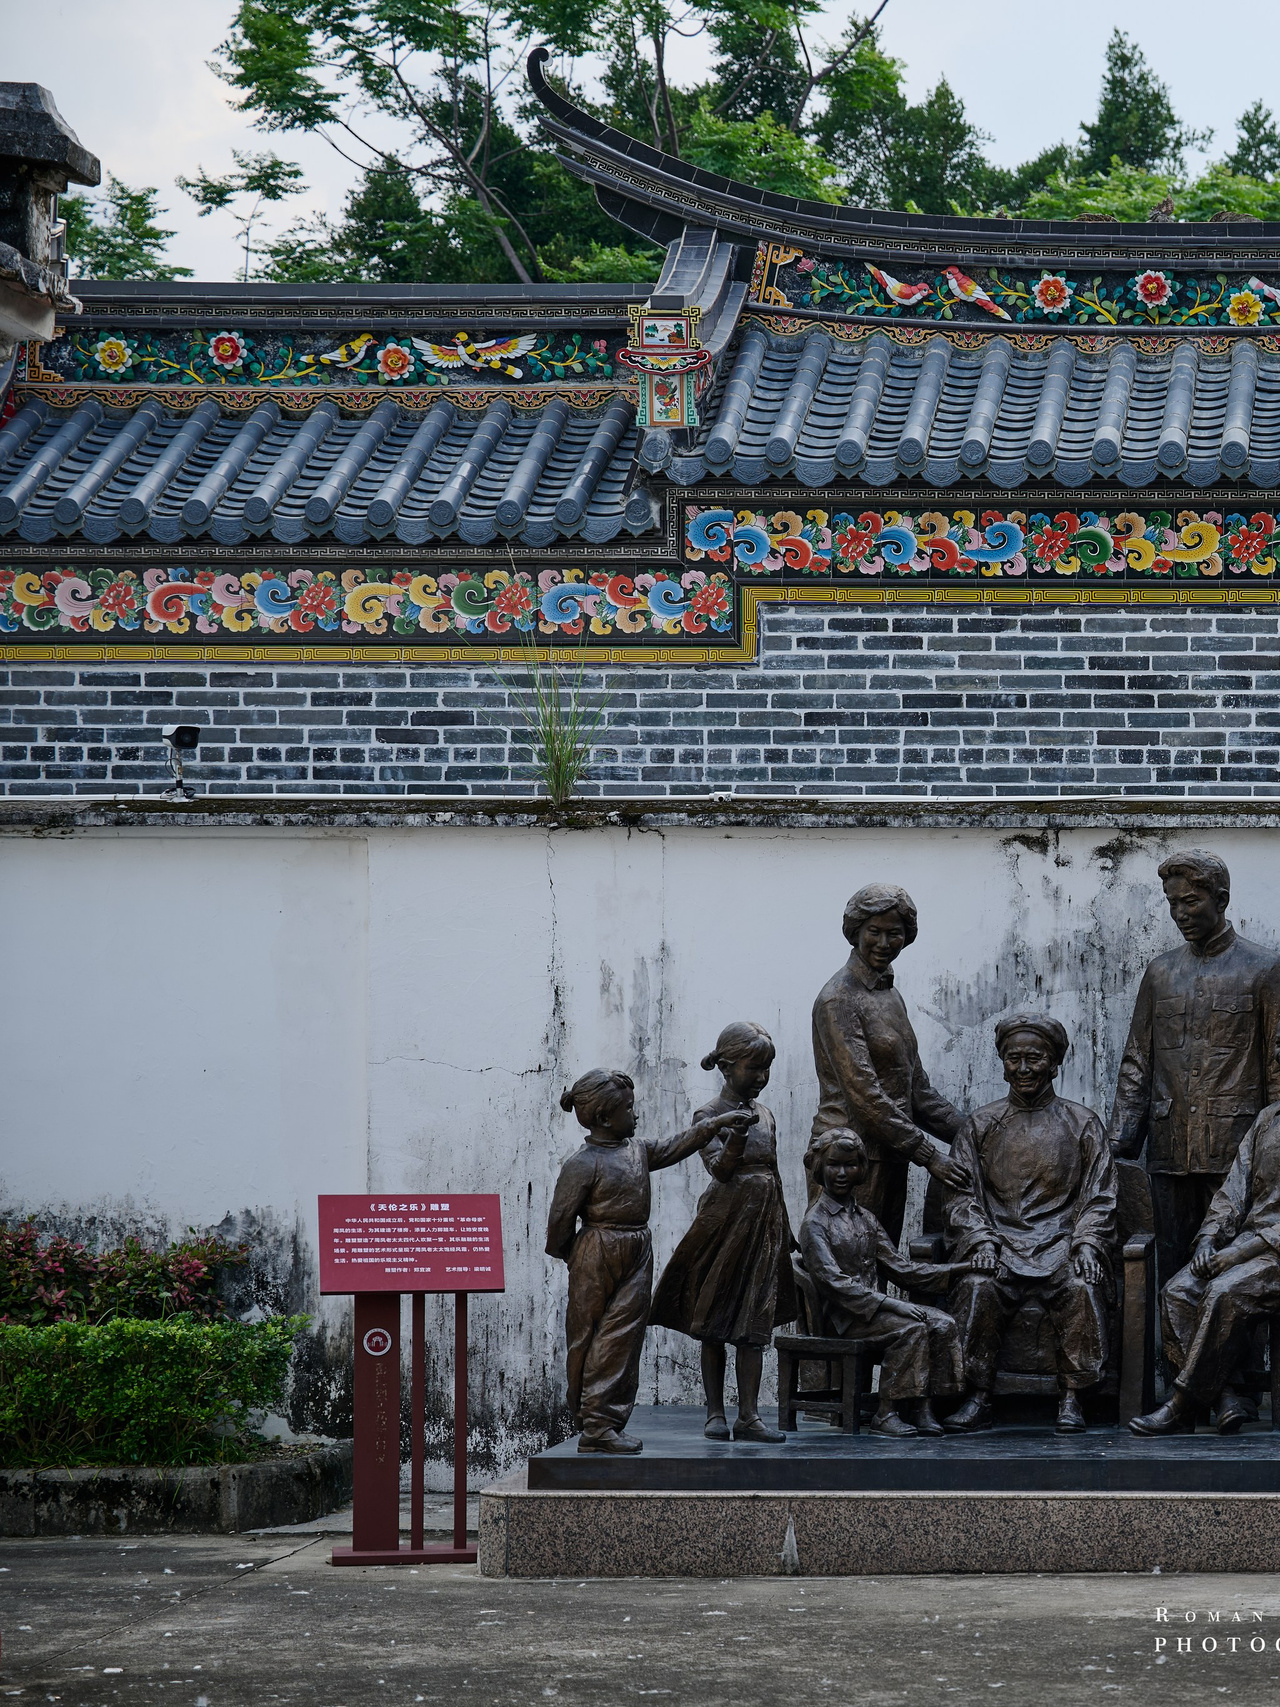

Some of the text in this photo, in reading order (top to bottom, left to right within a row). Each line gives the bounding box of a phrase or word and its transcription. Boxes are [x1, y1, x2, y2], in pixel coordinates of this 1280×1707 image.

[369, 1203, 450, 1212] 《天伦之乐》雕塑
